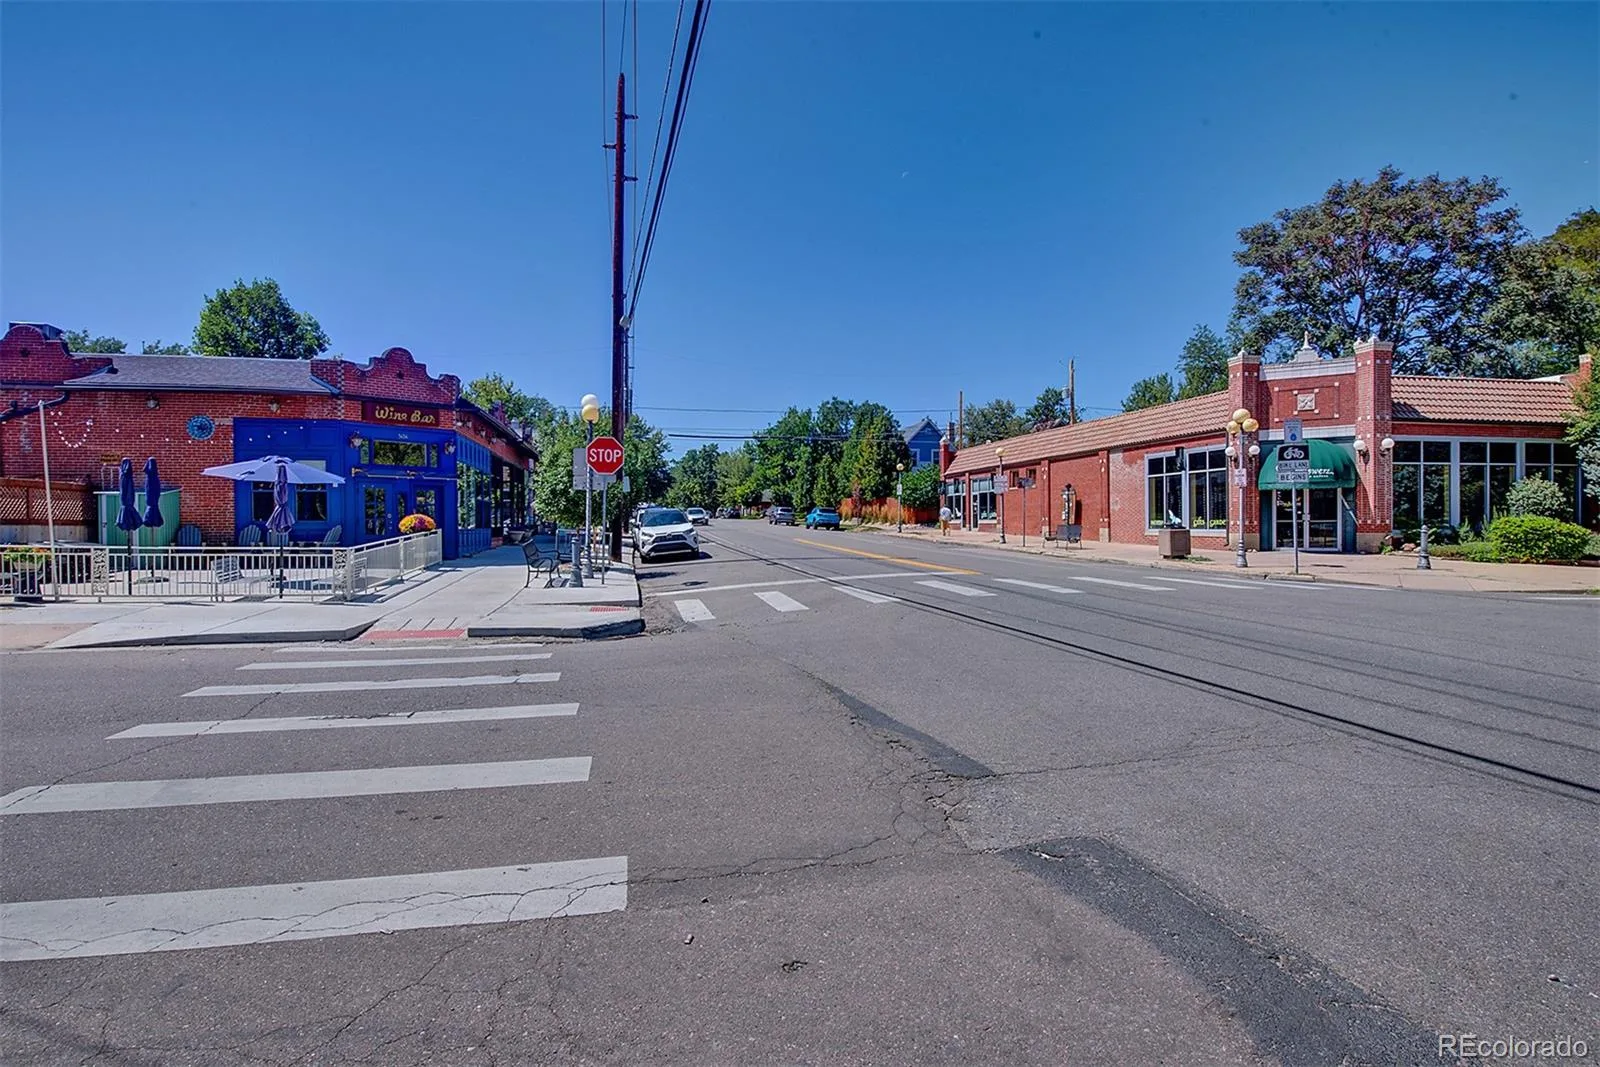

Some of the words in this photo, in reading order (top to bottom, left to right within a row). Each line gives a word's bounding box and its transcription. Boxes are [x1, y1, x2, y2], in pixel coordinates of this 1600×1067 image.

[375, 405, 408, 421] Wine
[411, 409, 436, 424] Bar
[589, 448, 622, 463] STOP
[1280, 473, 1307, 481] BEGINS
